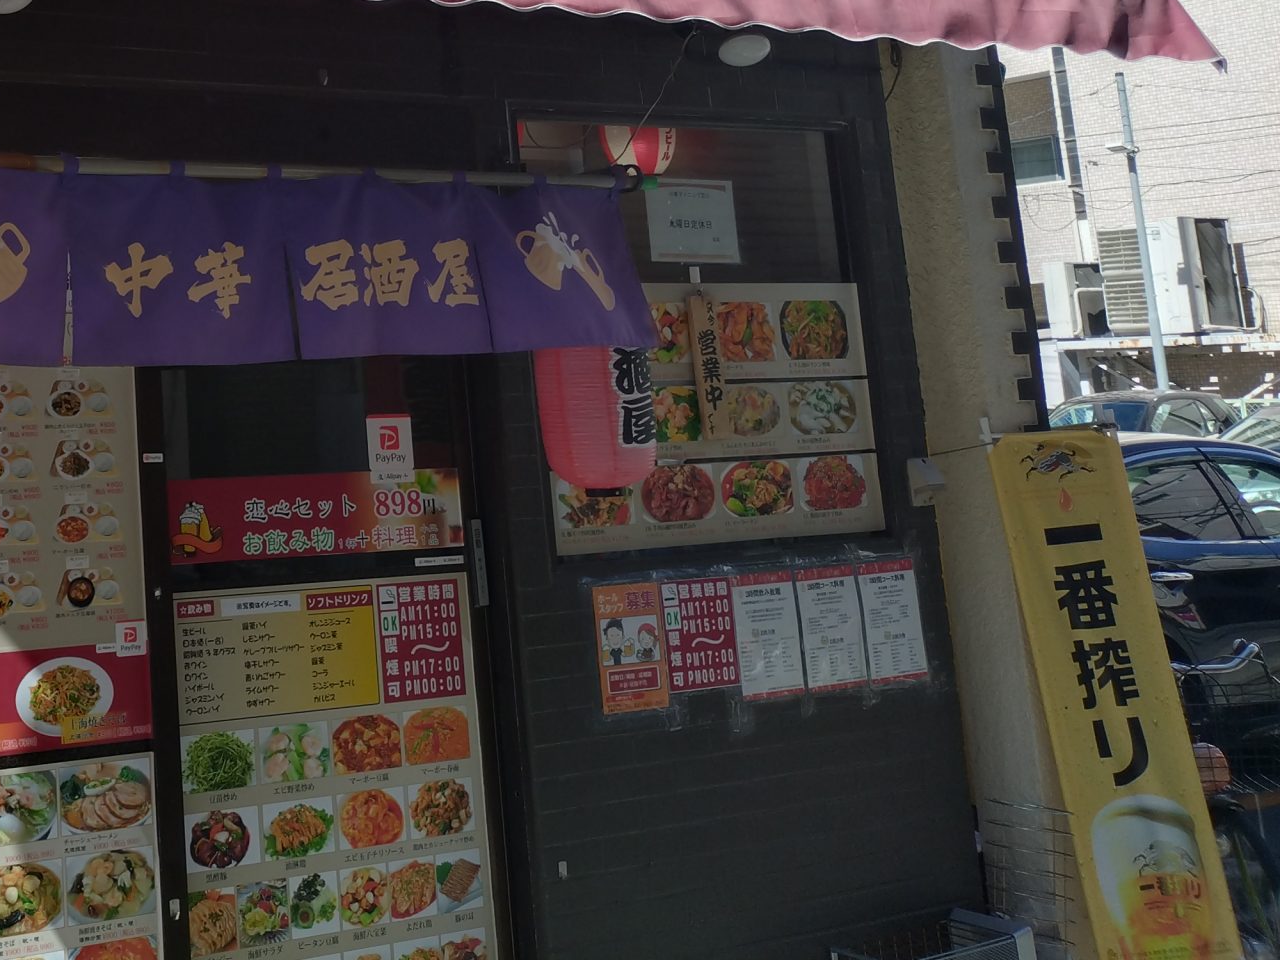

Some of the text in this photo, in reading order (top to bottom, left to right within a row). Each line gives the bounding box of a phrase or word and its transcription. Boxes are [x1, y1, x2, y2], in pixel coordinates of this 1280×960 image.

[104, 238, 478, 318] 中華 居酒屋
[375, 452, 407, 465] PayPay
[244, 493, 358, 524] 恋心セット
[398, 584, 455, 602] 営業時間
[678, 581, 728, 599] 営業時間
[308, 593, 369, 608] ソフトドリンク
[625, 591, 656, 610] 募集
[681, 598, 729, 617] AM11:00
[400, 602, 456, 622] AM11:00
[667, 613, 680, 626] OK
[383, 616, 398, 632] OK
[401, 621, 457, 640] PM15:00
[683, 616, 731, 635] PM15:00
[686, 648, 734, 668] PM17:00
[1044, 523, 1151, 789] 一番搾り
[404, 656, 460, 677] PM17:00
[688, 666, 736, 685] PM00:00
[406, 675, 461, 696] PM00:00
